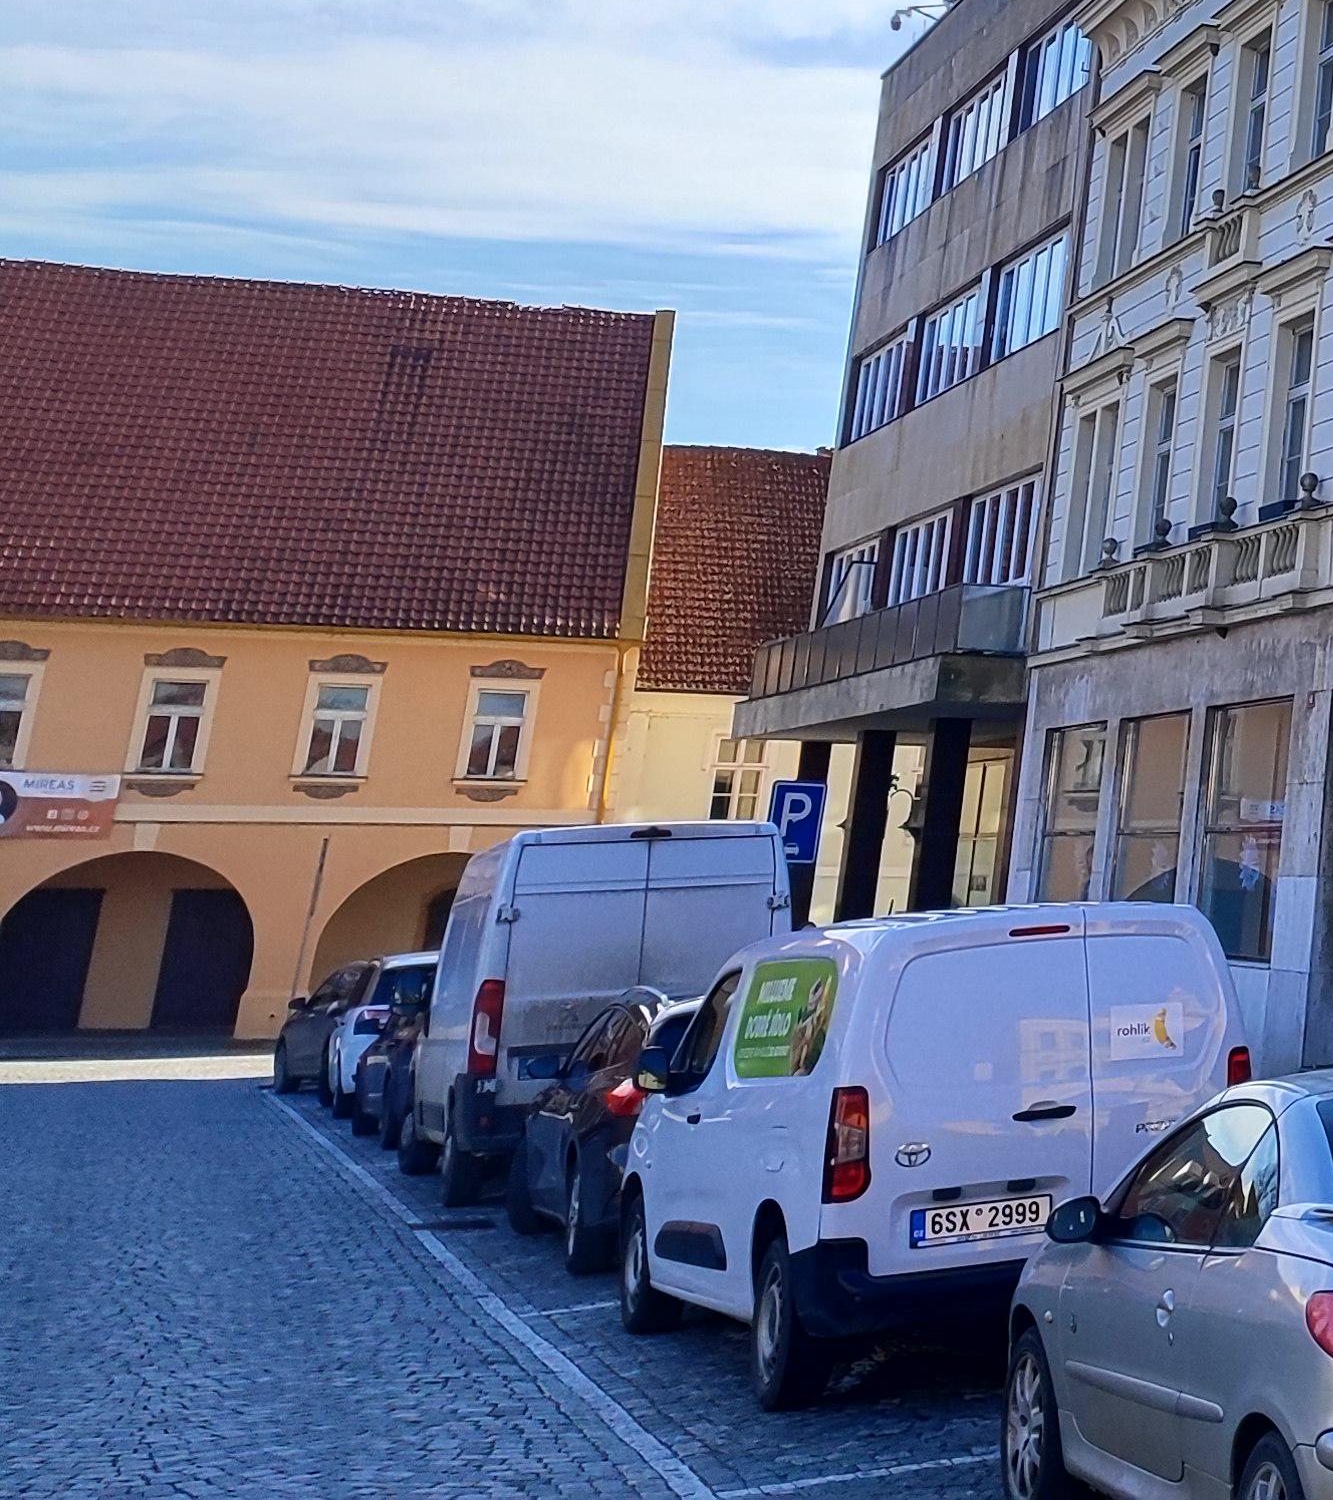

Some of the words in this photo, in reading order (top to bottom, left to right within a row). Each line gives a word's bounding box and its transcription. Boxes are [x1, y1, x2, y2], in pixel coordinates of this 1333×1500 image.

[23, 779, 76, 790] MIREAS
[779, 792, 813, 838] P
[1116, 1023, 1151, 1037] rohlik
[931, 1208, 971, 1235] 6SX
[987, 1200, 1041, 1229] 2999
